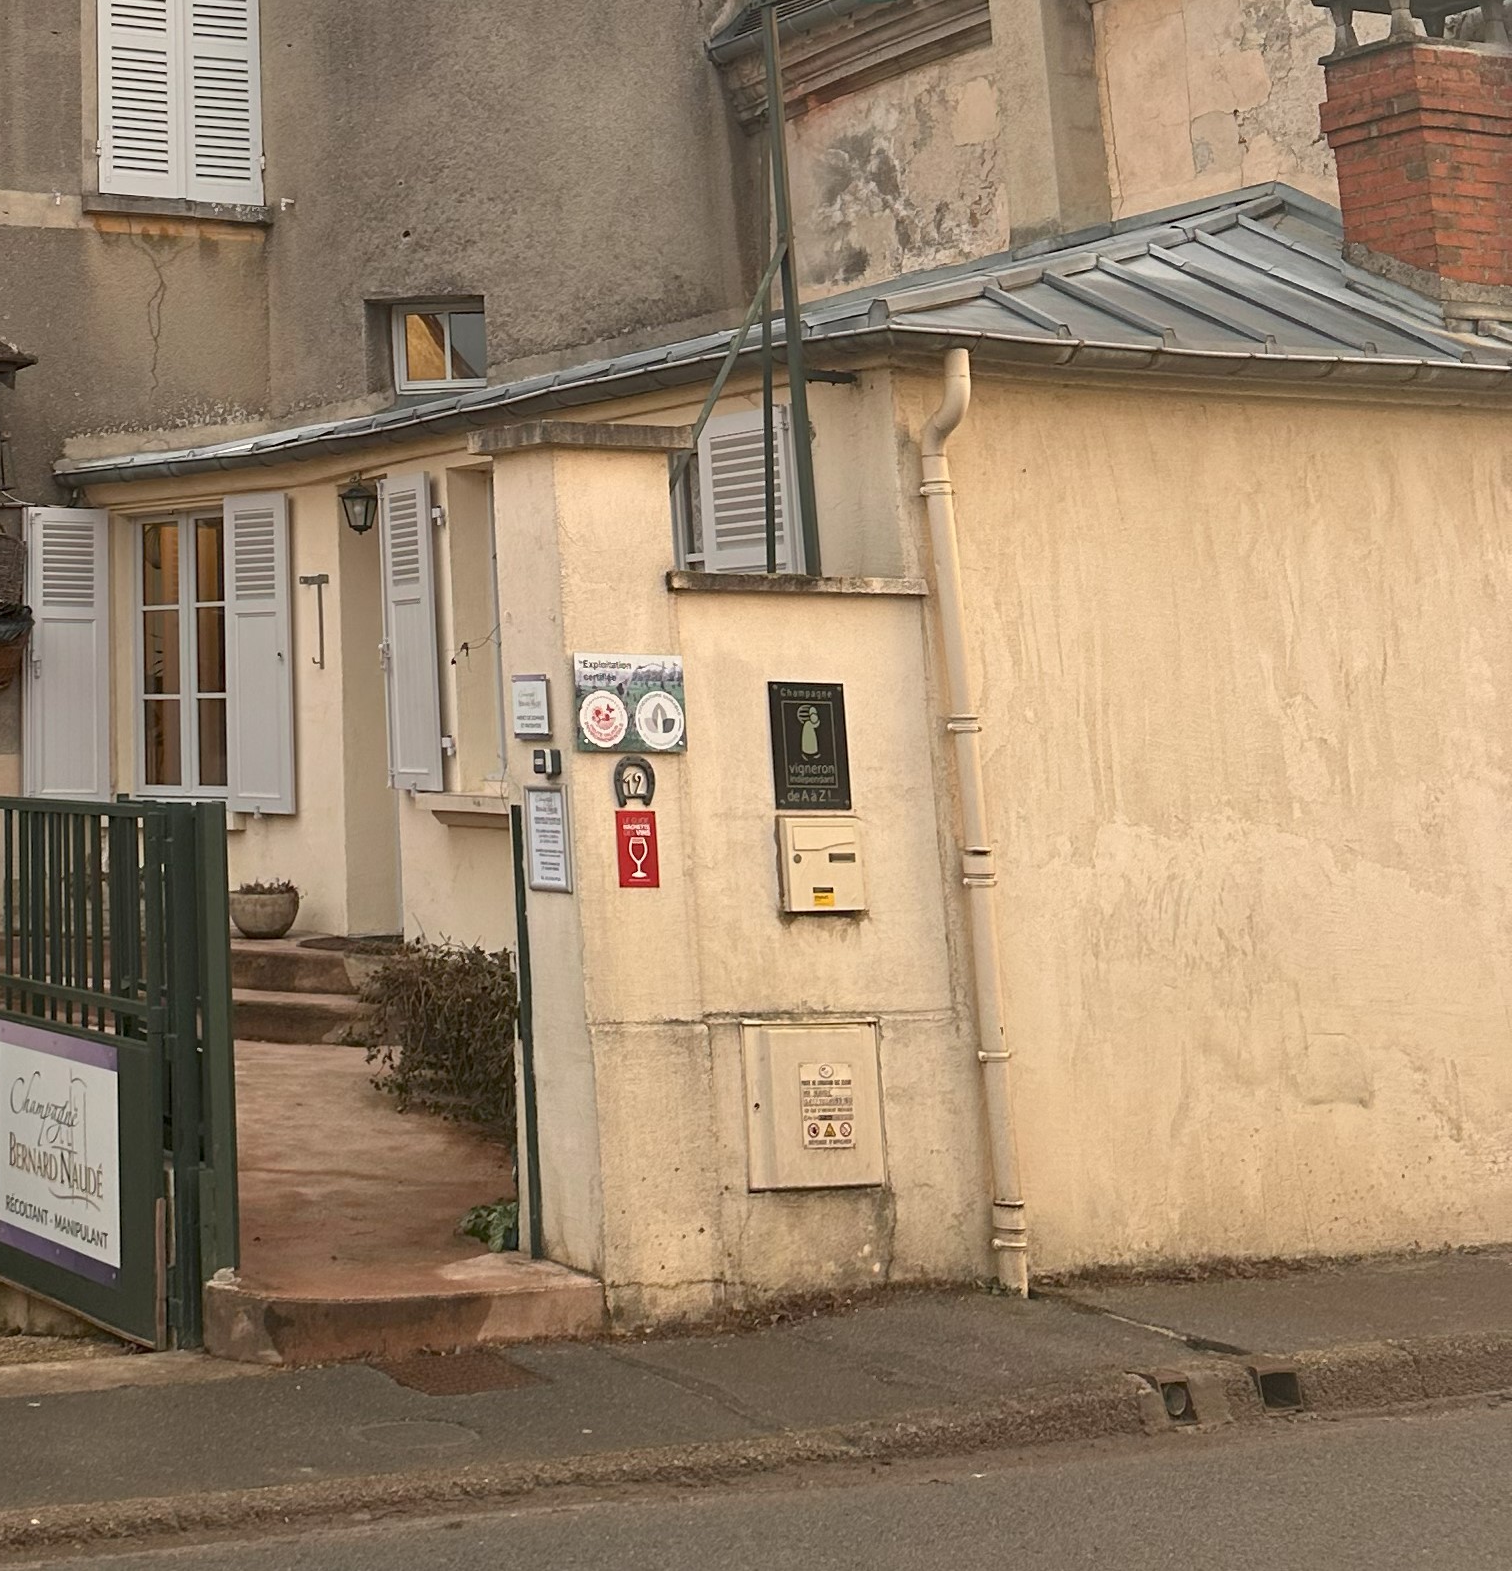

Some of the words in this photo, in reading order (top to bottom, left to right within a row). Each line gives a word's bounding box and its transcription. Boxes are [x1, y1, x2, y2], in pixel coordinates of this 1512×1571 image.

[583, 659, 632, 670] Exploitation
[780, 688, 833, 699] Champagne
[789, 762, 835, 776] vigneron
[622, 772, 646, 795] 12
[787, 790, 800, 802] de
[10, 1071, 79, 1146] Champagne
[9, 1131, 58, 1181] BERNARD
[60, 1151, 104, 1199] NAUDÉ
[5, 1193, 48, 1226] RÉCOLTANT
[54, 1213, 108, 1250] MANIPULANT
